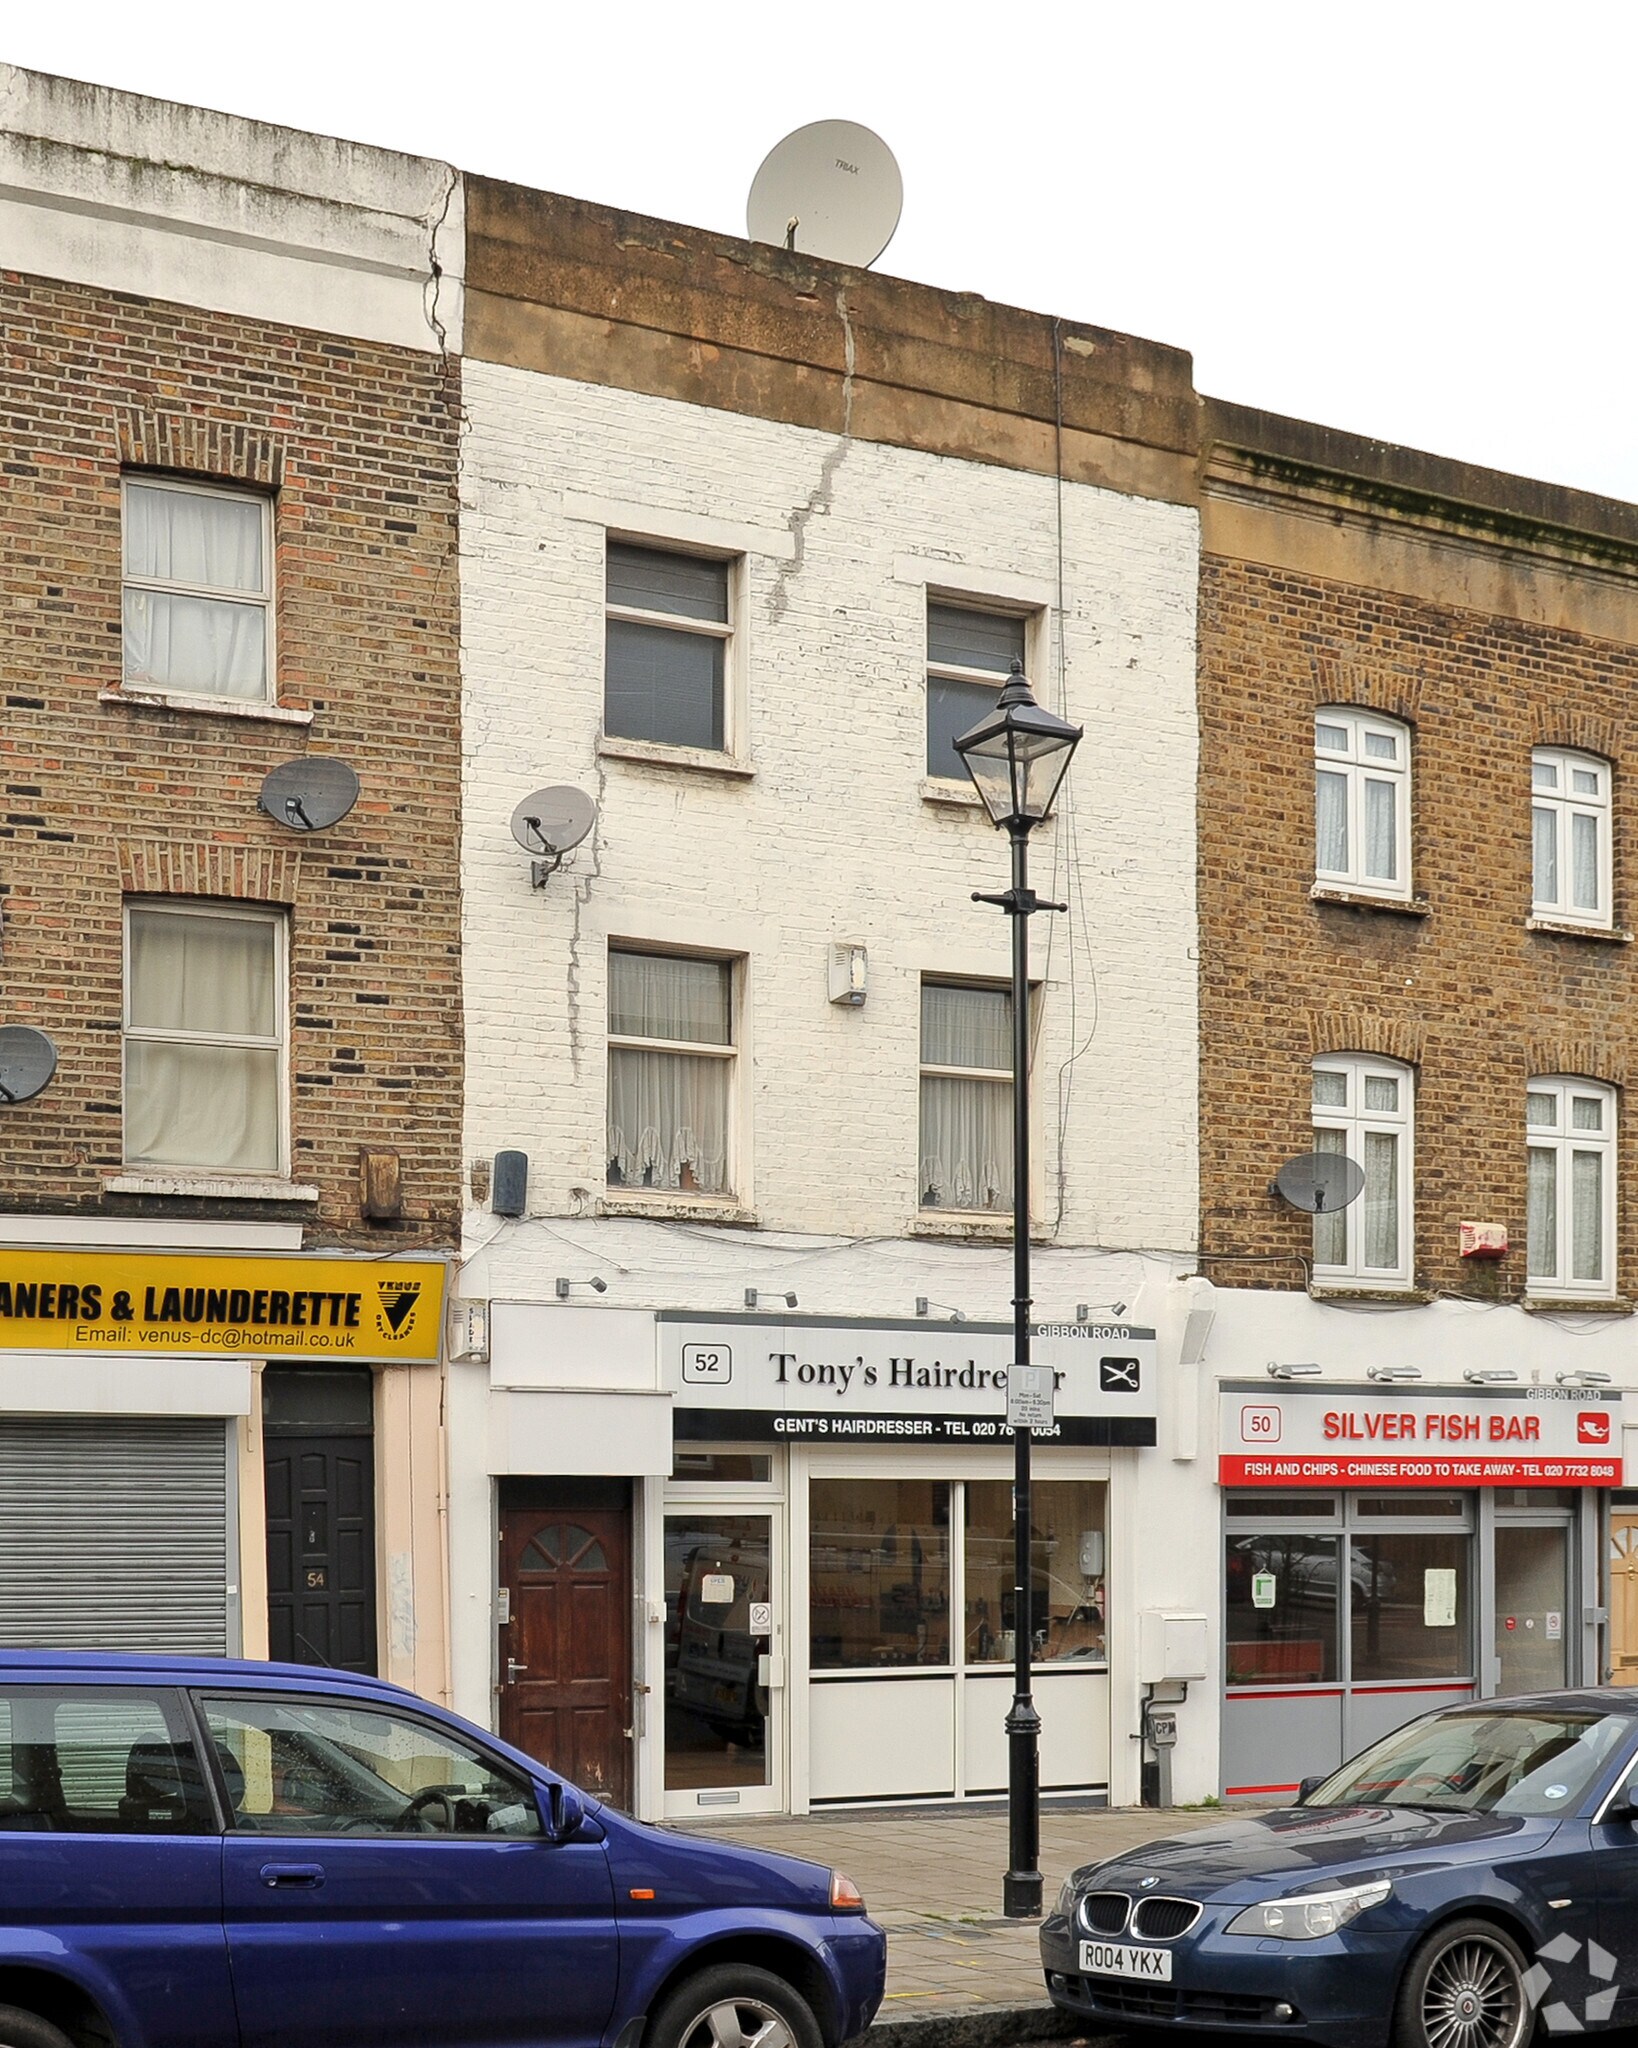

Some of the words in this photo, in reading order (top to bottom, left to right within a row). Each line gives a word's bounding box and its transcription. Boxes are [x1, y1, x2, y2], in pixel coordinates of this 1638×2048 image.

[835, 158, 860, 175] TRIAX
[377, 1281, 421, 1291] VENUS
[111, 1290, 135, 1322] &
[144, 1286, 362, 1327] LAUNDERETTE
[75, 1325, 132, 1342] Email:
[138, 1328, 355, 1348] venus-dc@hotmail.co.uk
[1037, 1324, 1089, 1339] GIBBON
[1093, 1326, 1130, 1340] ROAD
[695, 1353, 719, 1372] 52
[768, 1353, 878, 1395] Tony's
[889, 1357, 1066, 1391] Hairdrer
[1526, 1388, 1569, 1400] GIBBON
[1571, 1389, 1601, 1401] ROAD
[773, 1417, 829, 1434] GENT'S
[832, 1419, 933, 1435] HAIRDRESSER
[945, 1421, 970, 1435] TEL
[972, 1422, 996, 1436] 020
[1251, 1415, 1271, 1433] 50
[1323, 1412, 1417, 1439] SILVER
[1425, 1414, 1481, 1440] FISH
[1489, 1415, 1540, 1441] BAR
[1244, 1463, 1272, 1476] FISH
[1274, 1463, 1300, 1476] AND
[1302, 1463, 1339, 1476] CHIPS
[1347, 1463, 1398, 1477] CHINESE
[1399, 1463, 1432, 1477] FOOD
[1434, 1463, 1450, 1476] TO
[1452, 1464, 1482, 1476] TAKE
[1483, 1464, 1516, 1477] AWAY
[1522, 1464, 1543, 1477] TEL
[1544, 1464, 1563, 1477] 020
[1565, 1465, 1588, 1477] 7732
[1590, 1465, 1615, 1478] 8048
[307, 1572, 325, 1587] 54
[1129, 1949, 1164, 1975] YKX
